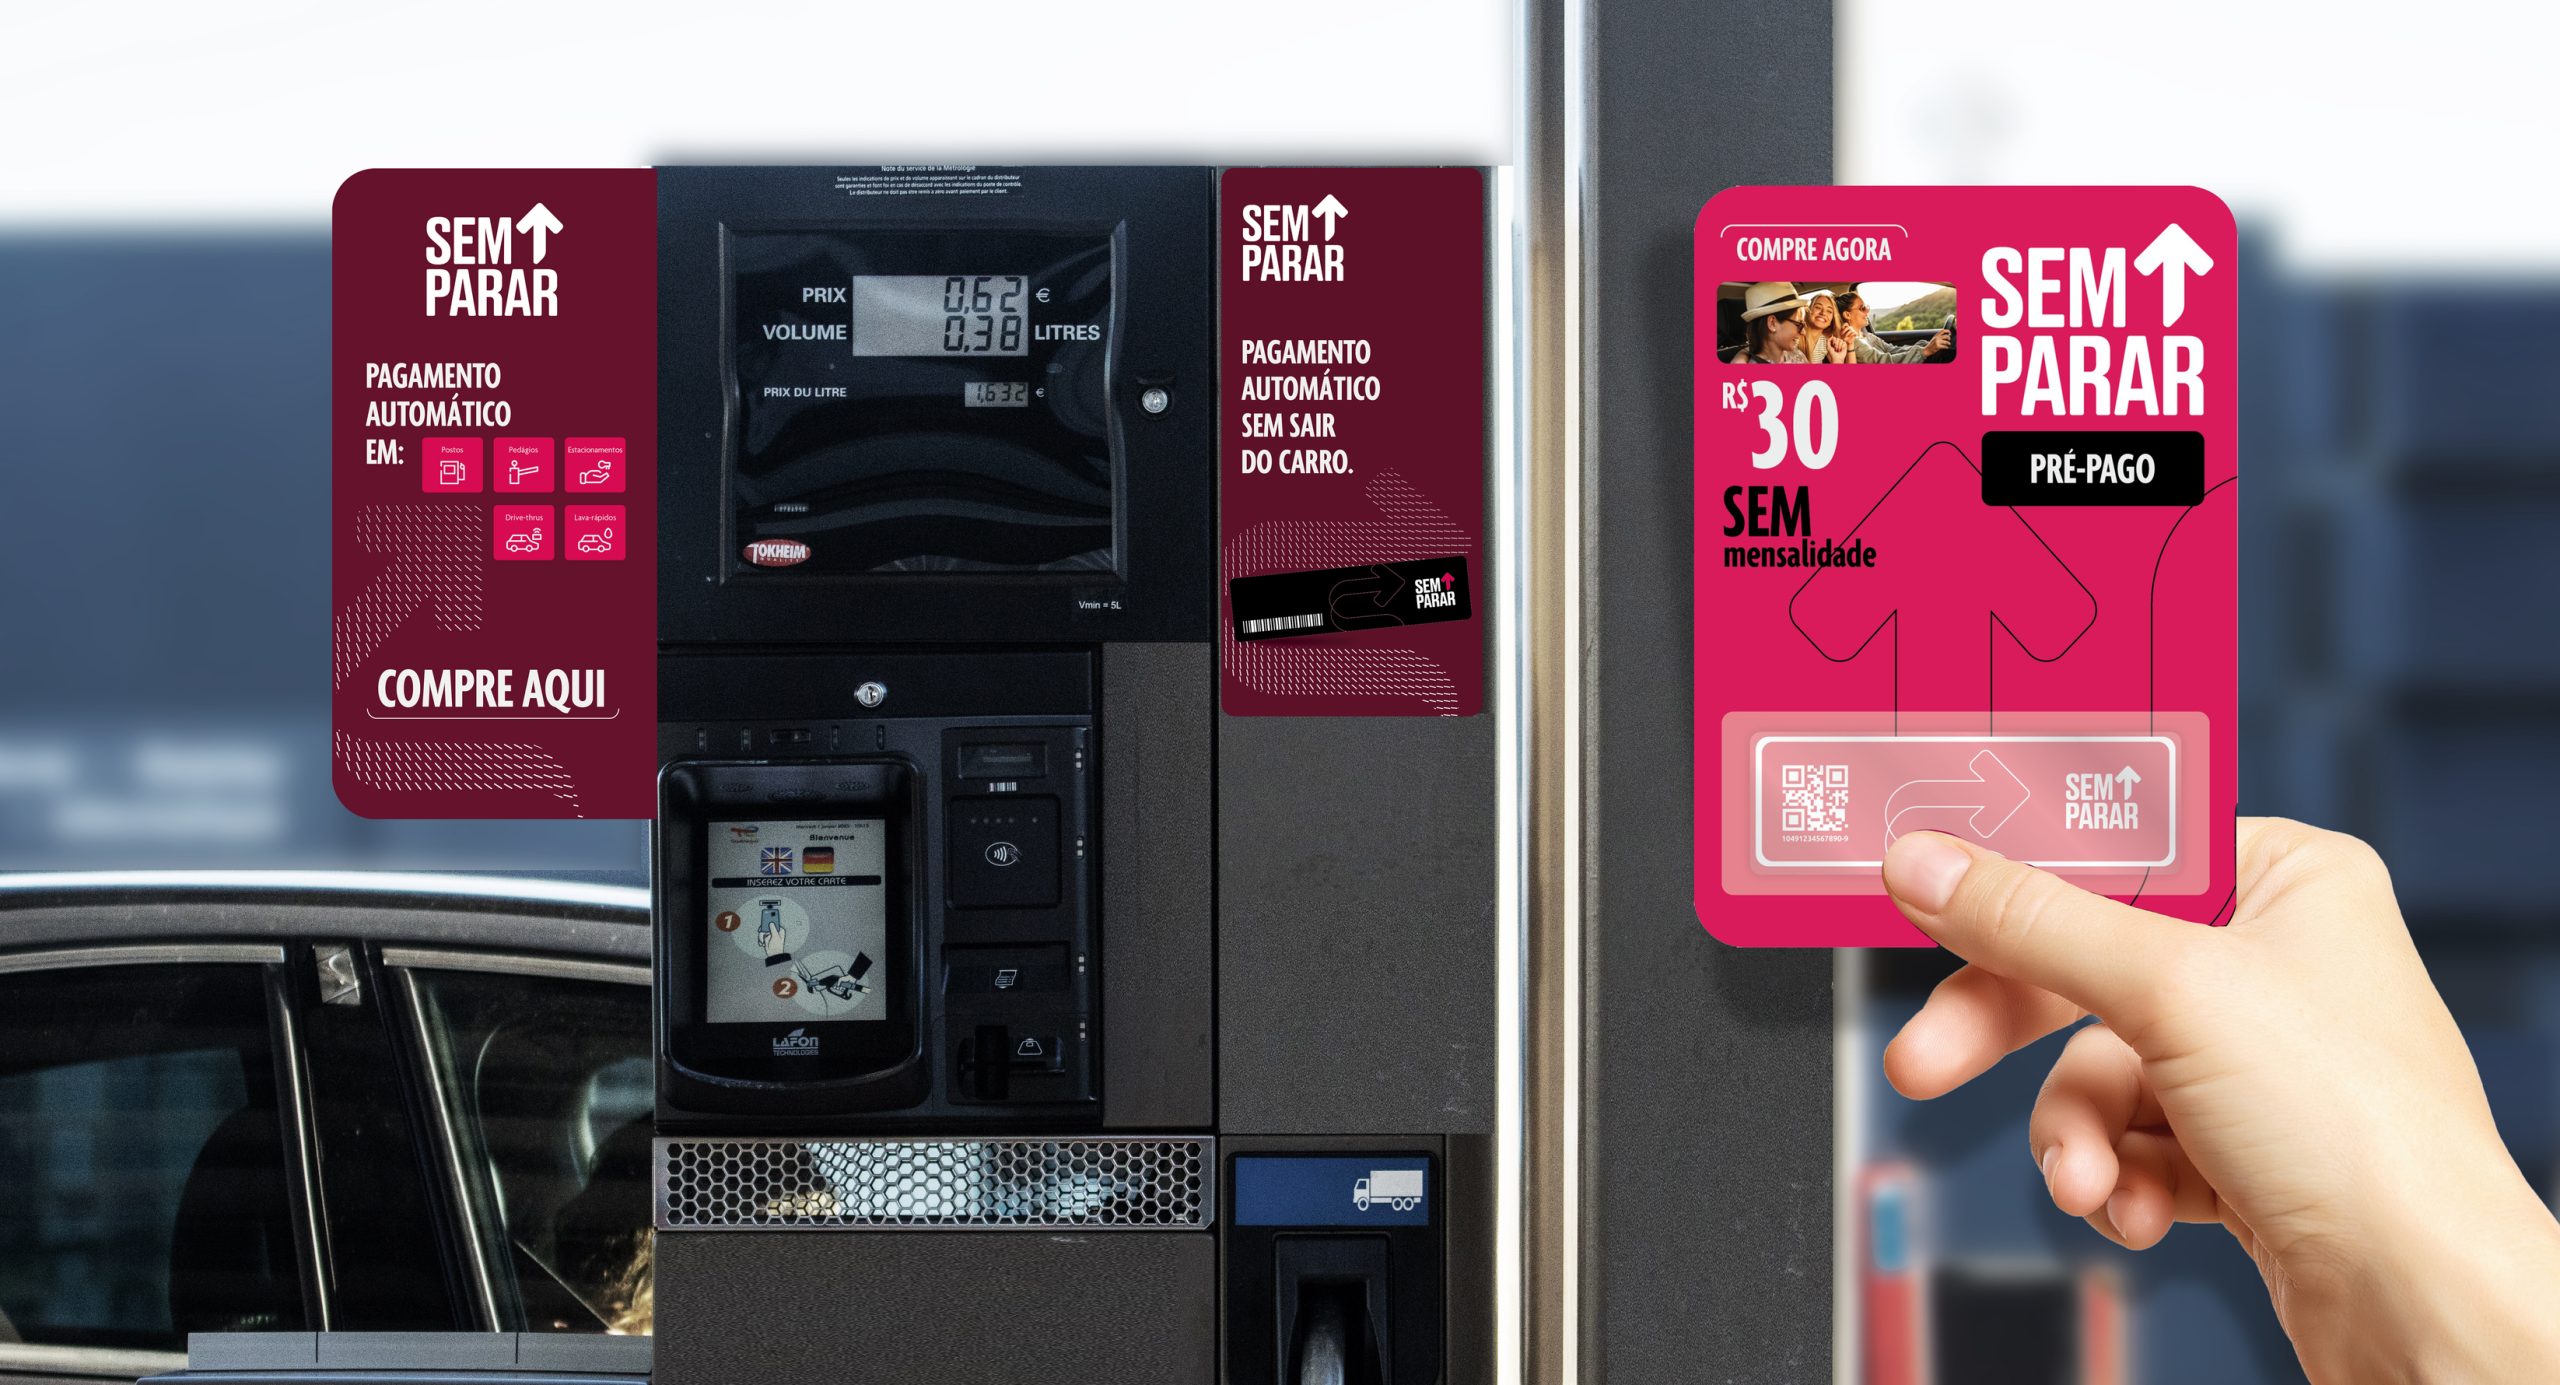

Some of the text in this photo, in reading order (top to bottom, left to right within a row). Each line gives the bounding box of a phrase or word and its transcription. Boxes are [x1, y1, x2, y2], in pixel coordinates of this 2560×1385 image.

[928, 164, 935, 172] de
[1242, 204, 1309, 242] SEM
[425, 216, 512, 266] SEM
[1736, 237, 1892, 262] COMPRE AGORA
[1242, 244, 1345, 282] PARAR
[426, 268, 558, 317] PARAR
[802, 275, 1051, 315] PRIX 0,62 €
[1981, 246, 2127, 329] SEM
[762, 315, 1101, 353] VOLUME 0,38 LITRES
[1242, 339, 1371, 365] PAGAMENTO
[366, 362, 502, 389] PAGAMENTO
[1241, 367, 1381, 401] AUTOMÁTICO
[1981, 335, 2205, 416] PARAR
[763, 384, 1045, 403] PRIX DU LITRE 1,632 €
[365, 392, 512, 427] AUTOMÁTICO
[1241, 412, 1337, 438] SEM SAIR
[1721, 378, 1840, 470] R$ 30
[366, 438, 404, 465] EM:
[441, 446, 464, 454] Postos
[508, 446, 539, 456] Pedágios
[567, 446, 623, 454] Estacionamentos
[1241, 449, 1354, 475] DO CARRO.
[2030, 448, 2156, 484] PRÉ-PAGO
[505, 513, 544, 522] Drive-thrus
[574, 513, 617, 523] Lava-rápidos
[1723, 485, 1812, 538] SEM
[747, 544, 807, 564] TOKHEIM
[1722, 538, 1878, 569] mensalidade
[1414, 577, 1441, 595] SEM
[1078, 600, 1101, 609] Vmin
[1110, 600, 1123, 610] 5L
[1414, 591, 1457, 610] PARAR
[377, 668, 605, 714] COMPRE AQUI
[2065, 773, 2113, 801] SEM
[2065, 803, 2139, 829] PARAR
[747, 877, 847, 887] INSEREZ VOTRE CARTE
[725, 915, 732, 928] 1
[778, 981, 791, 995] 2
[772, 1036, 819, 1047] LAFON
